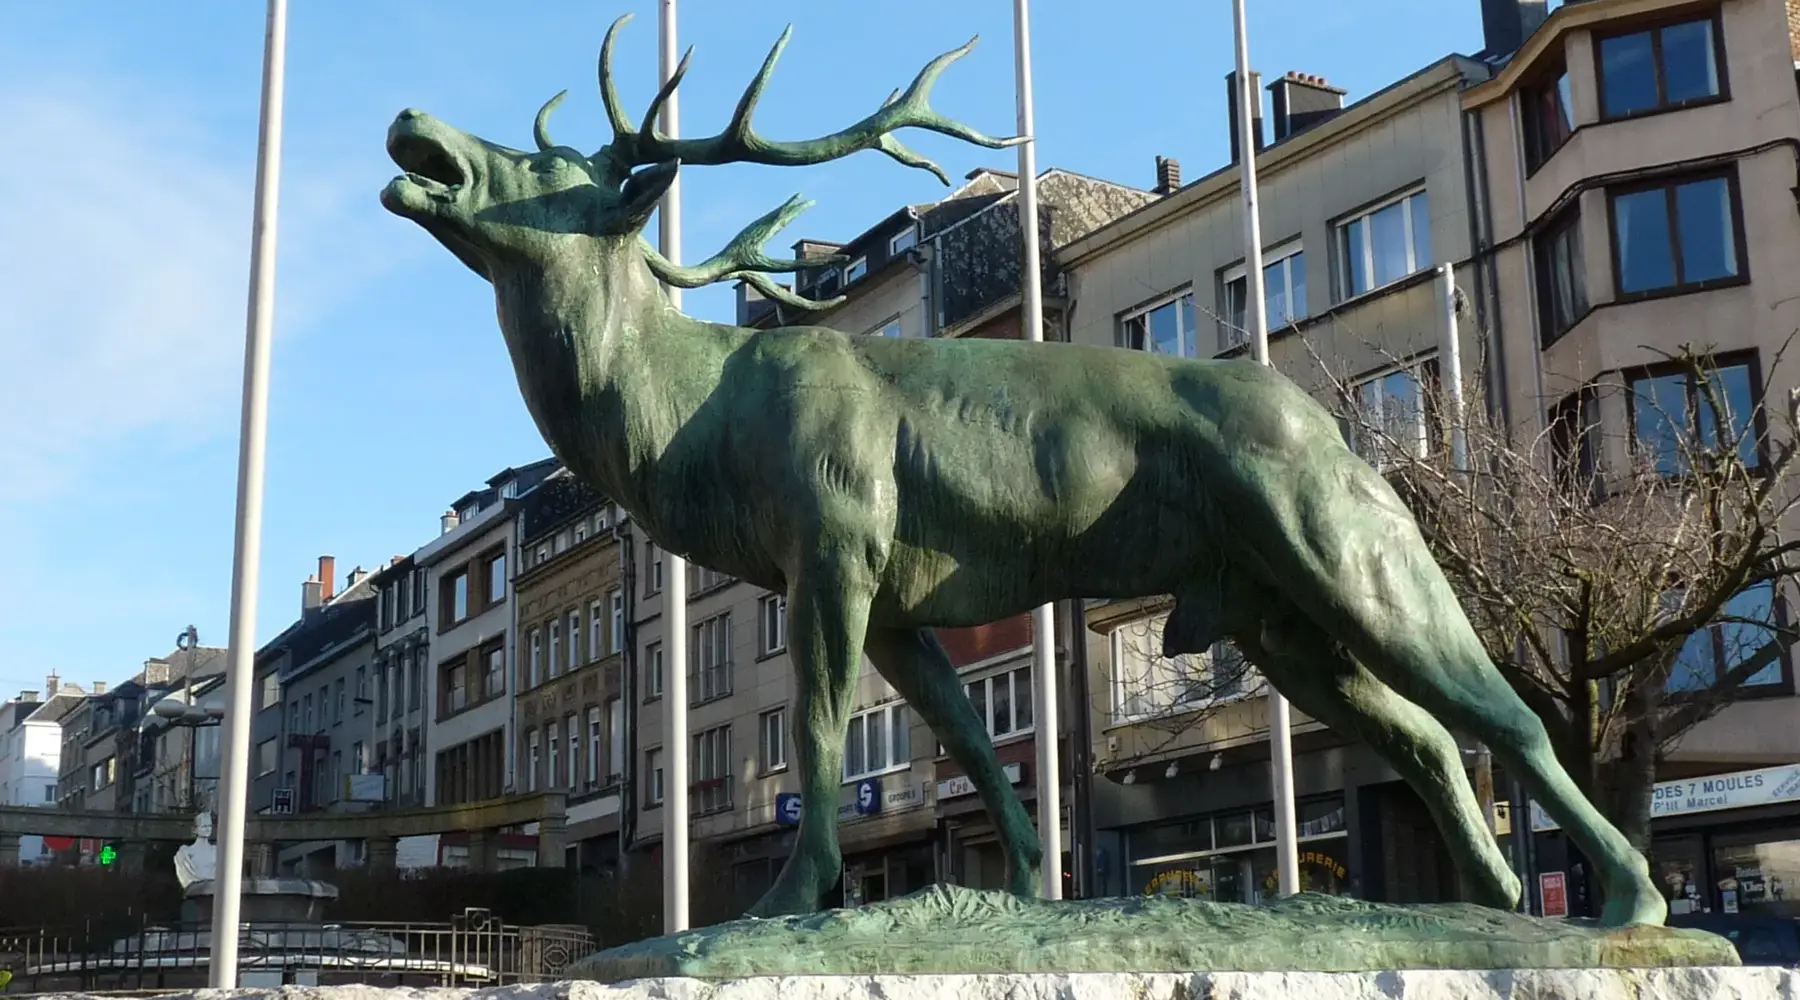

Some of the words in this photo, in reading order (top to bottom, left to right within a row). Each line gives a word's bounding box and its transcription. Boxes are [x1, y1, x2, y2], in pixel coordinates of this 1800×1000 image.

[1655, 785, 1683, 800] DES
[1688, 783, 1696, 795] 7
[1703, 774, 1764, 793] MOULES
[1686, 794, 1728, 809] Marcel
